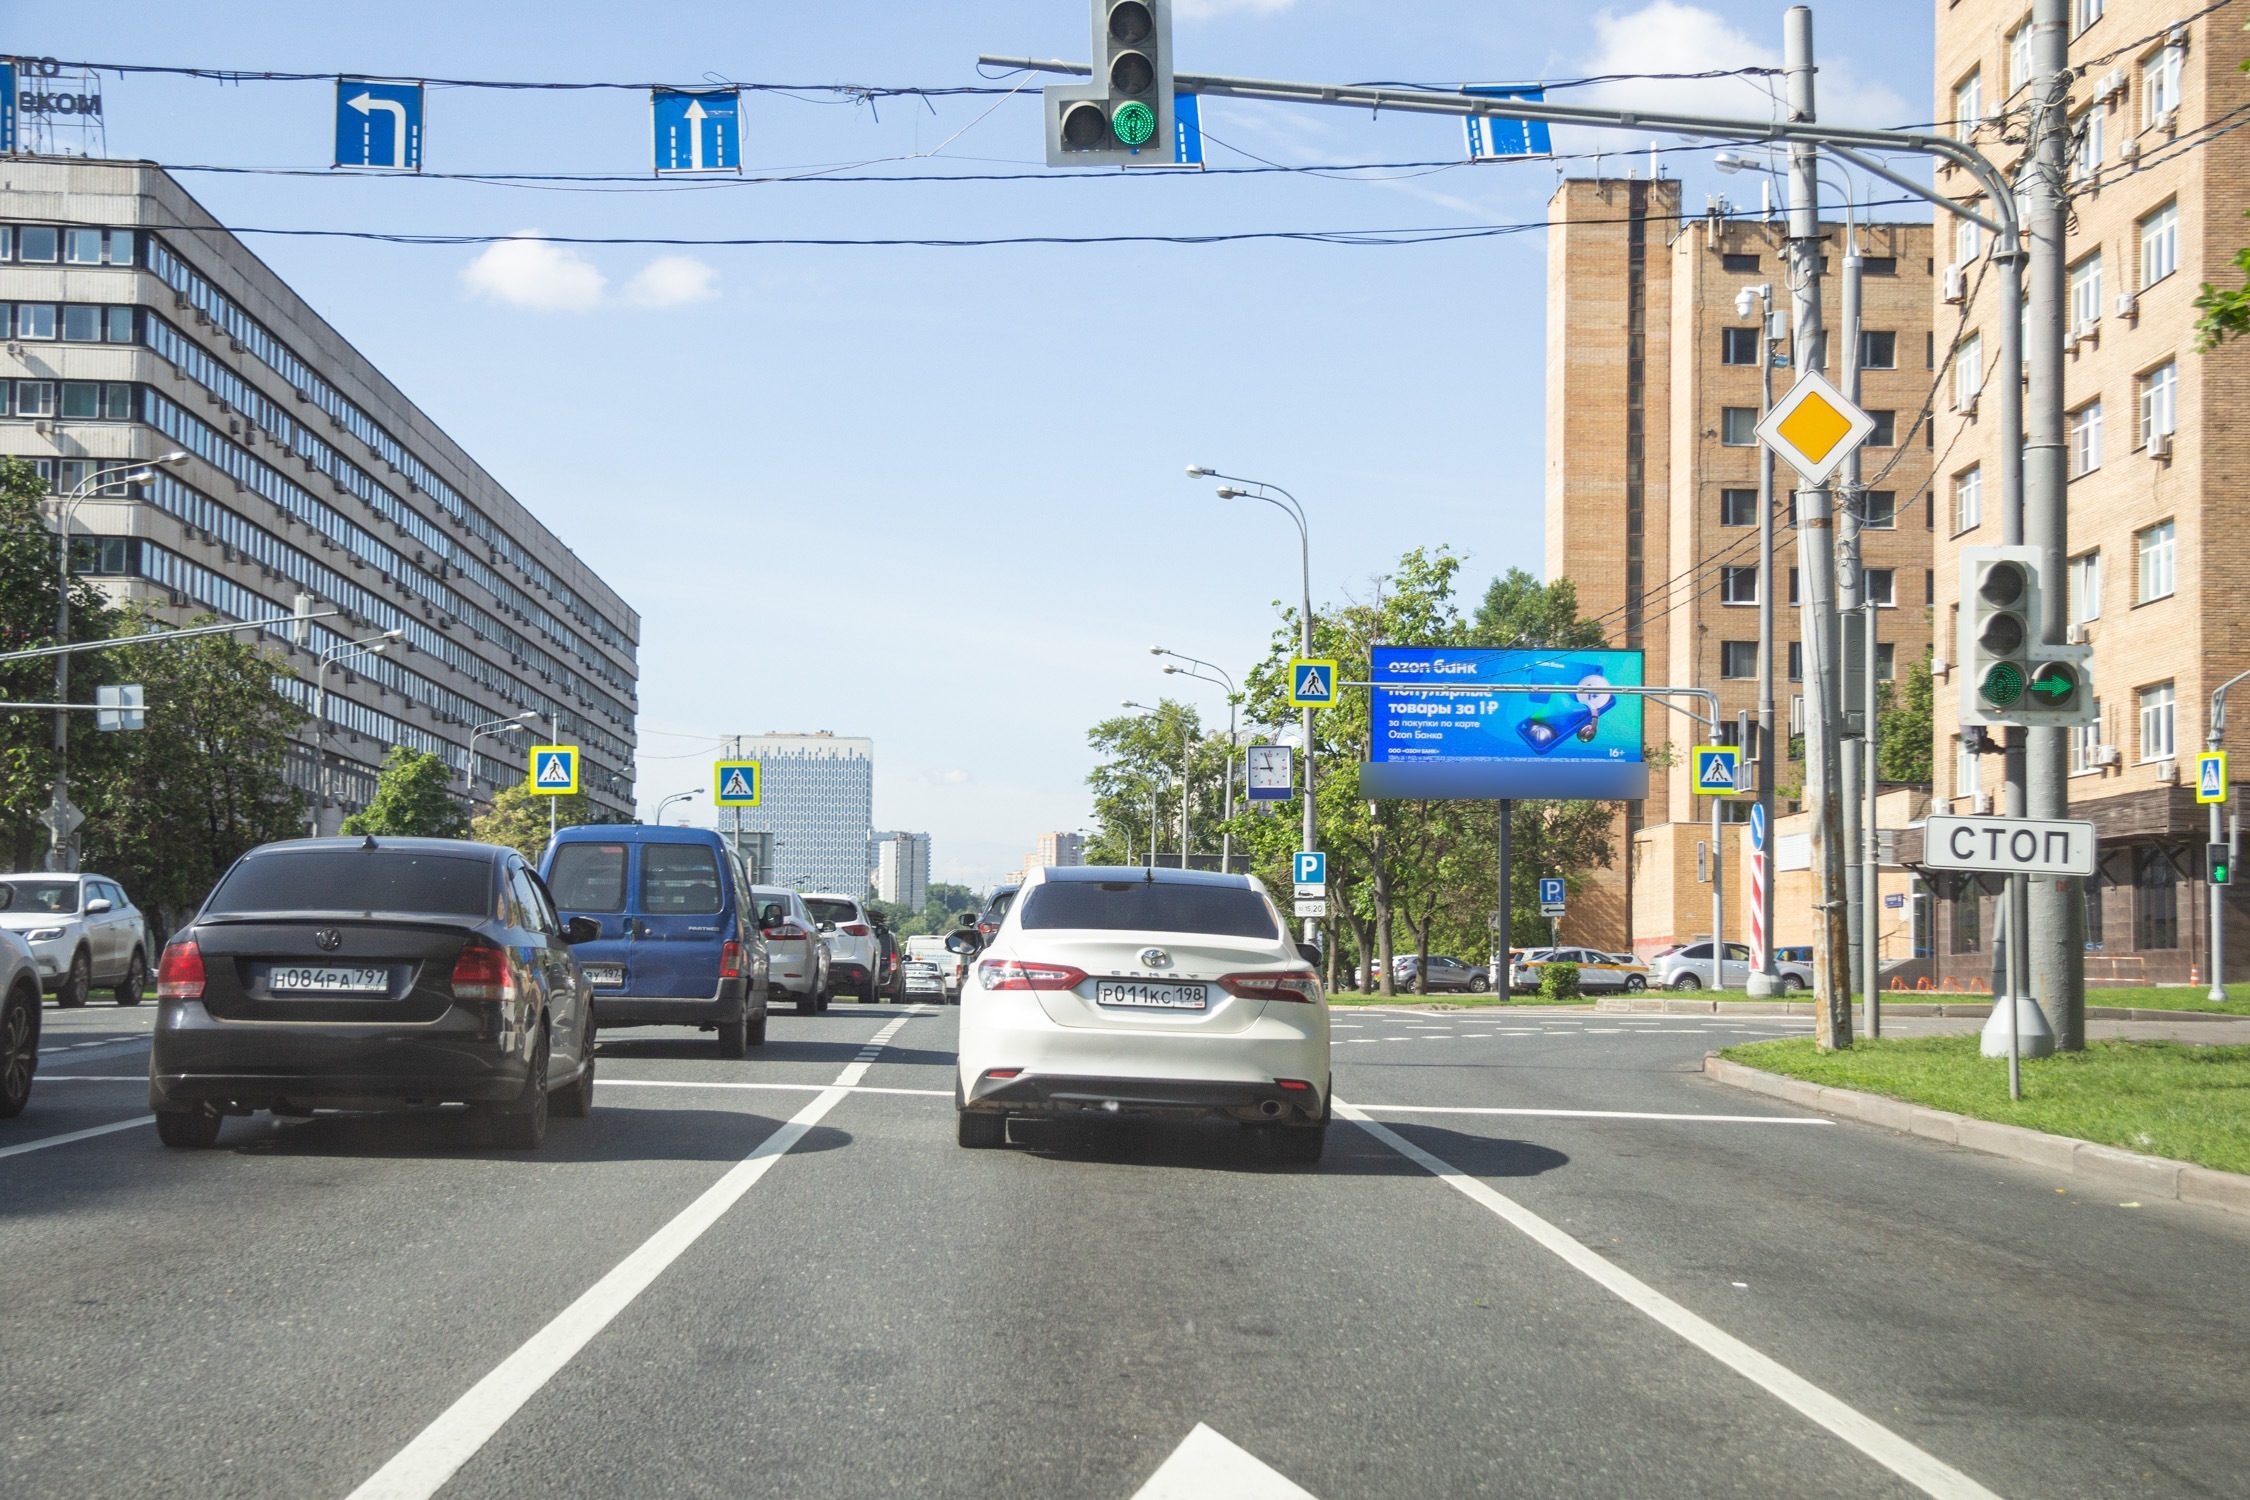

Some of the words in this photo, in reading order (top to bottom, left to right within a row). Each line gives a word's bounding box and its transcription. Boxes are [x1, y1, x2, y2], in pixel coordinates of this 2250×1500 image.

[20, 91, 102, 115] еком
[1388, 661, 1431, 673] ozon
[1433, 659, 1478, 674] банк
[1388, 703, 1451, 717] товары
[1455, 704, 1475, 715] за
[1402, 720, 1438, 728] покупки
[1454, 721, 1480, 729] карте
[1388, 730, 1412, 739] Ozon
[1414, 730, 1443, 739] Банка
[1609, 748, 1625, 757] 16+
[1949, 826, 2069, 864] СТОП
[1301, 856, 1318, 881] P
[1546, 881, 1560, 901] P
[274, 969, 351, 989] Н084РА
[356, 969, 385, 984] 797
[603, 969, 619, 978] 197
[1103, 985, 1172, 1004] Р011КС
[1176, 987, 1202, 1001] 198
